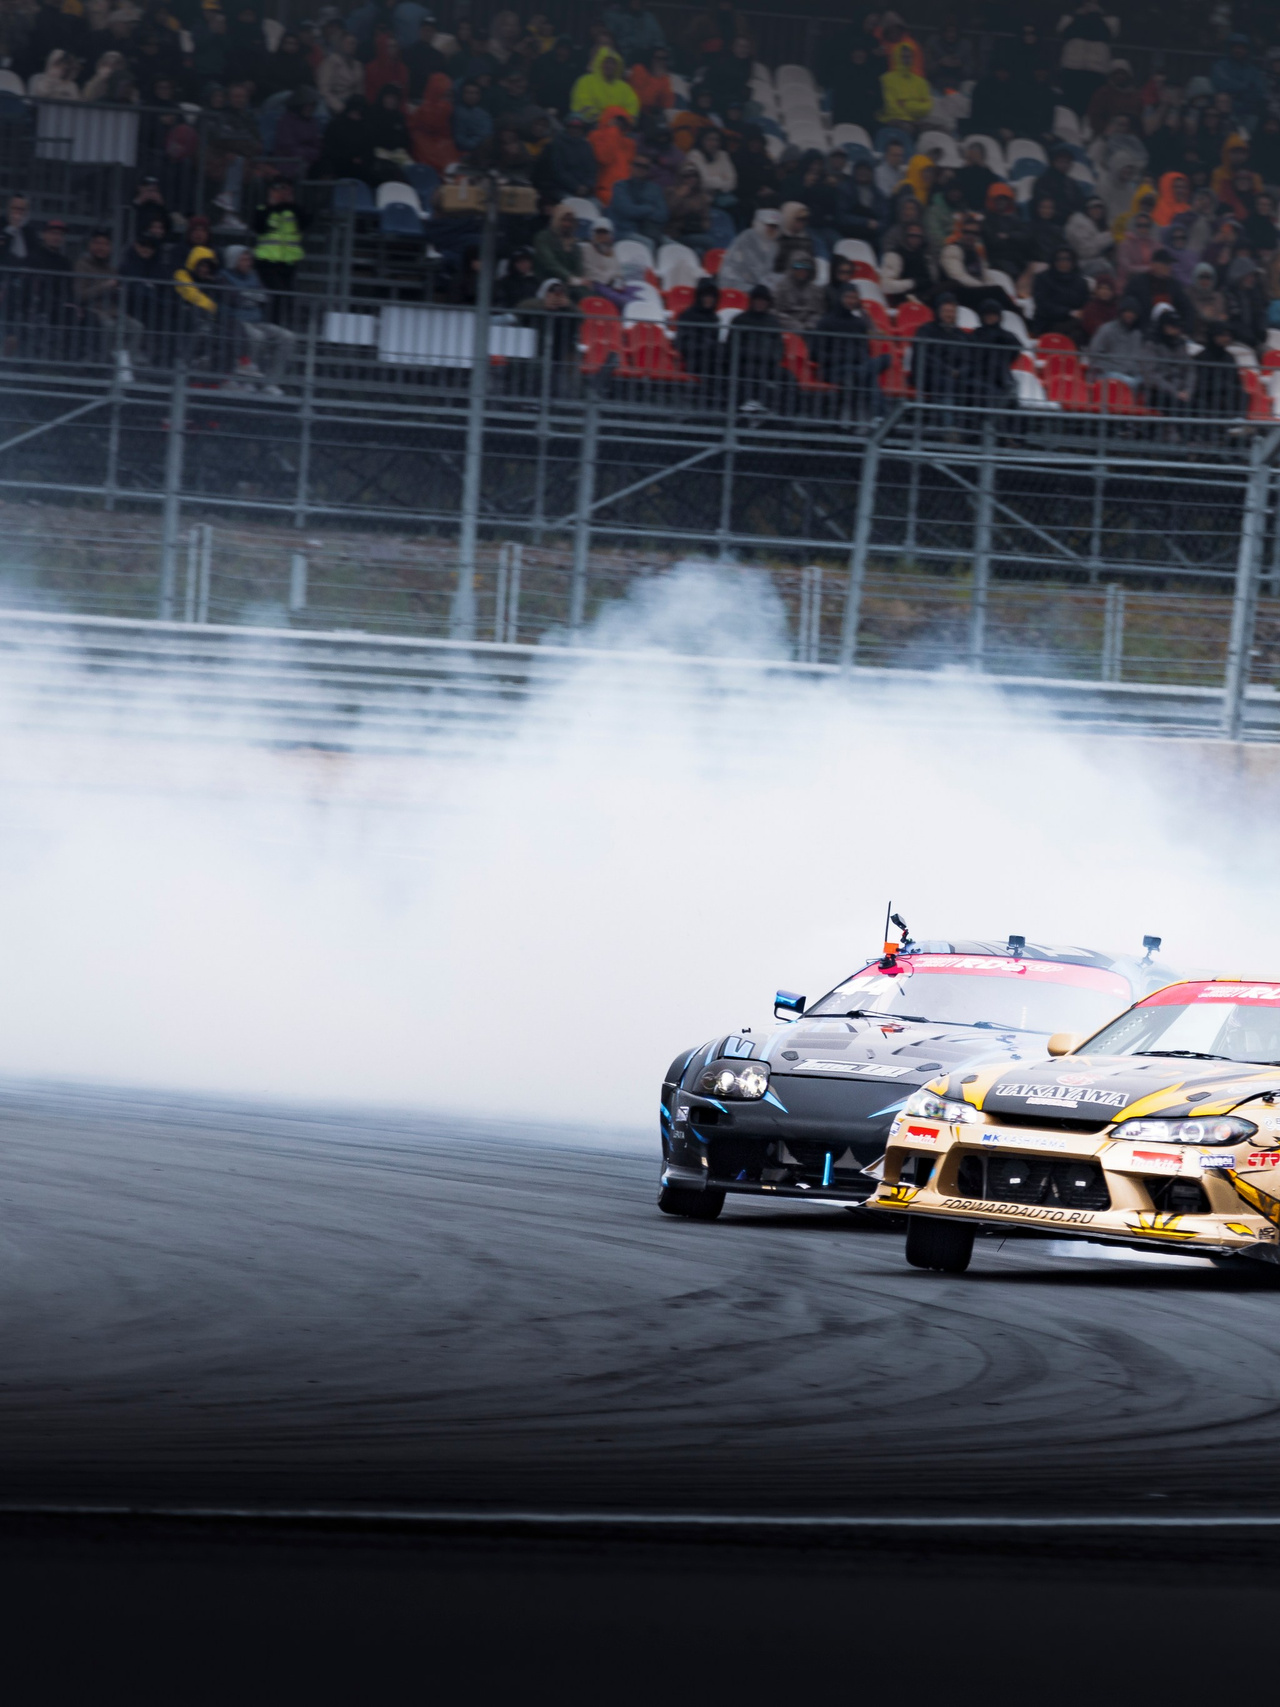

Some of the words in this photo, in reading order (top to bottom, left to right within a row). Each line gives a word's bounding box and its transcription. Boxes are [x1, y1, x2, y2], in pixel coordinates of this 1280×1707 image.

[953, 958, 1027, 972] RDS
[995, 1083, 1130, 1108] TAKAYAMA
[1247, 1152, 1280, 1166] CTR
[940, 1198, 1095, 1225] FORWARDAUTO.RU
